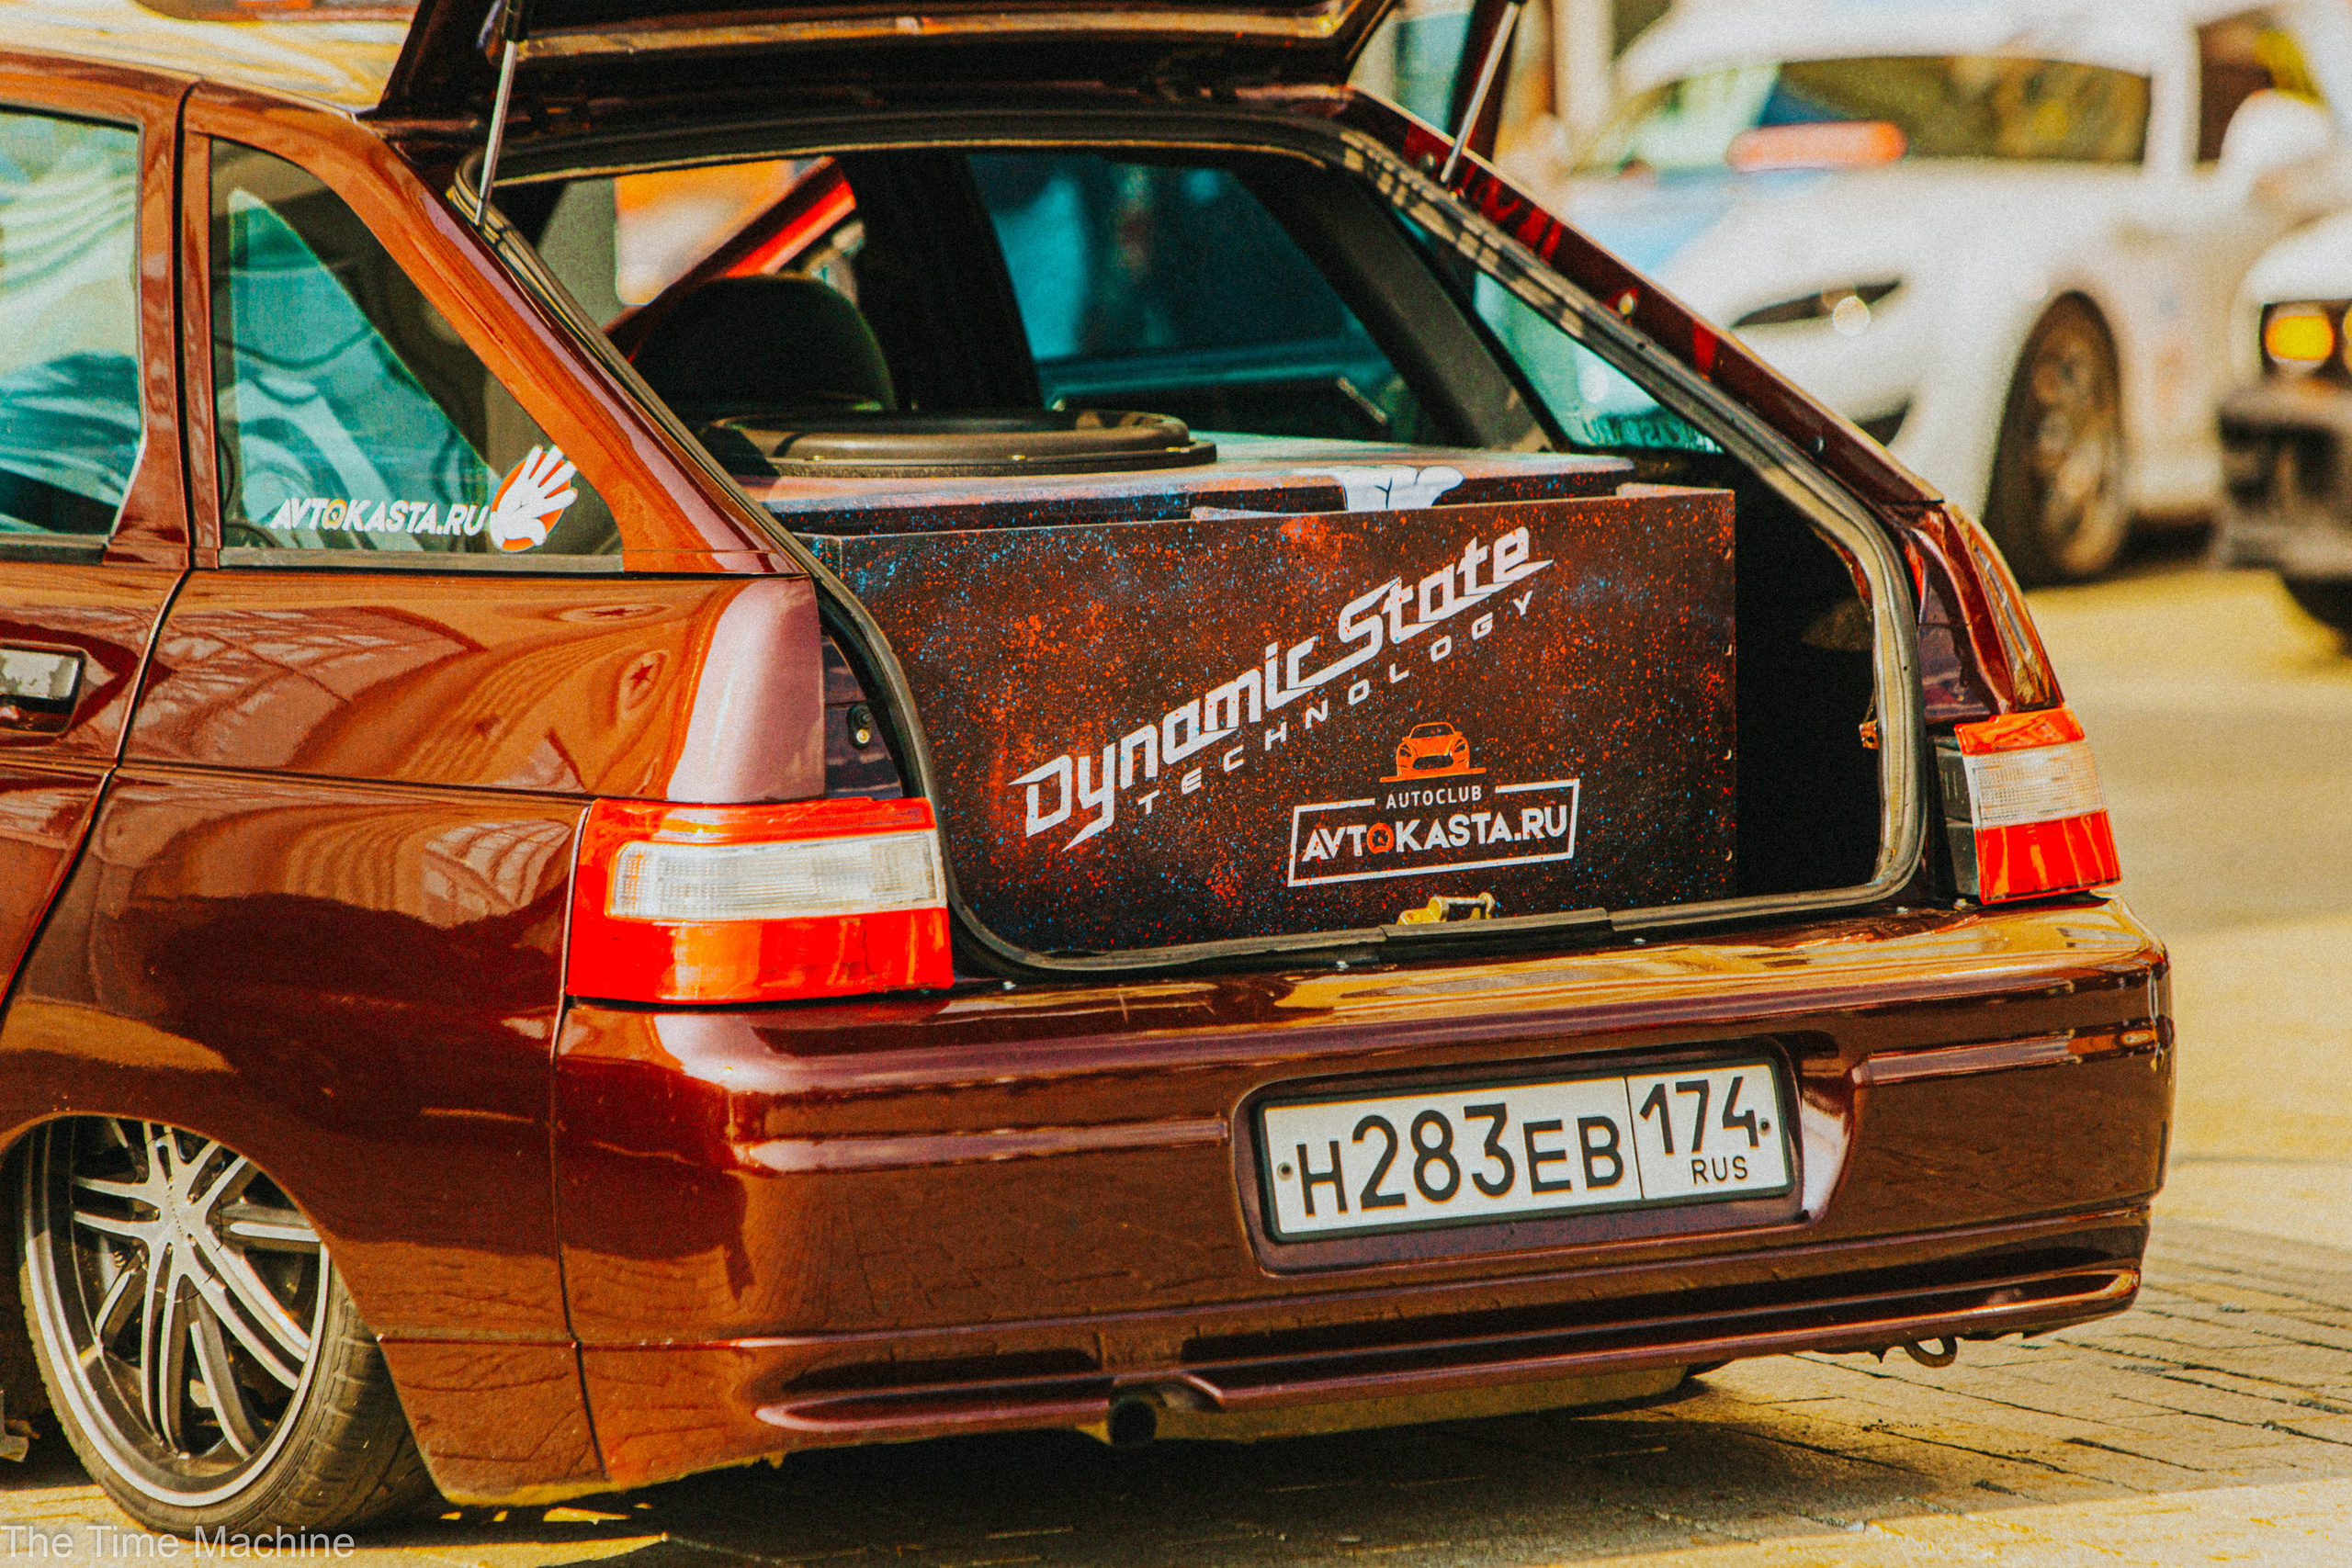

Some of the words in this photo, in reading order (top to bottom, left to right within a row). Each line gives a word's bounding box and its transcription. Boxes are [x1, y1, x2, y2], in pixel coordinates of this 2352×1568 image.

[269, 497, 490, 536] AVTOKASTA.RU
[1309, 525, 1555, 682] State
[1137, 591, 1533, 815] TECHNOLOGY
[1385, 785, 1483, 809] AUTOCLUB
[1302, 806, 1567, 862] AVTOKASTA.RU
[1639, 1076, 1759, 1156] 174
[1691, 1156, 1749, 1185] RUS
